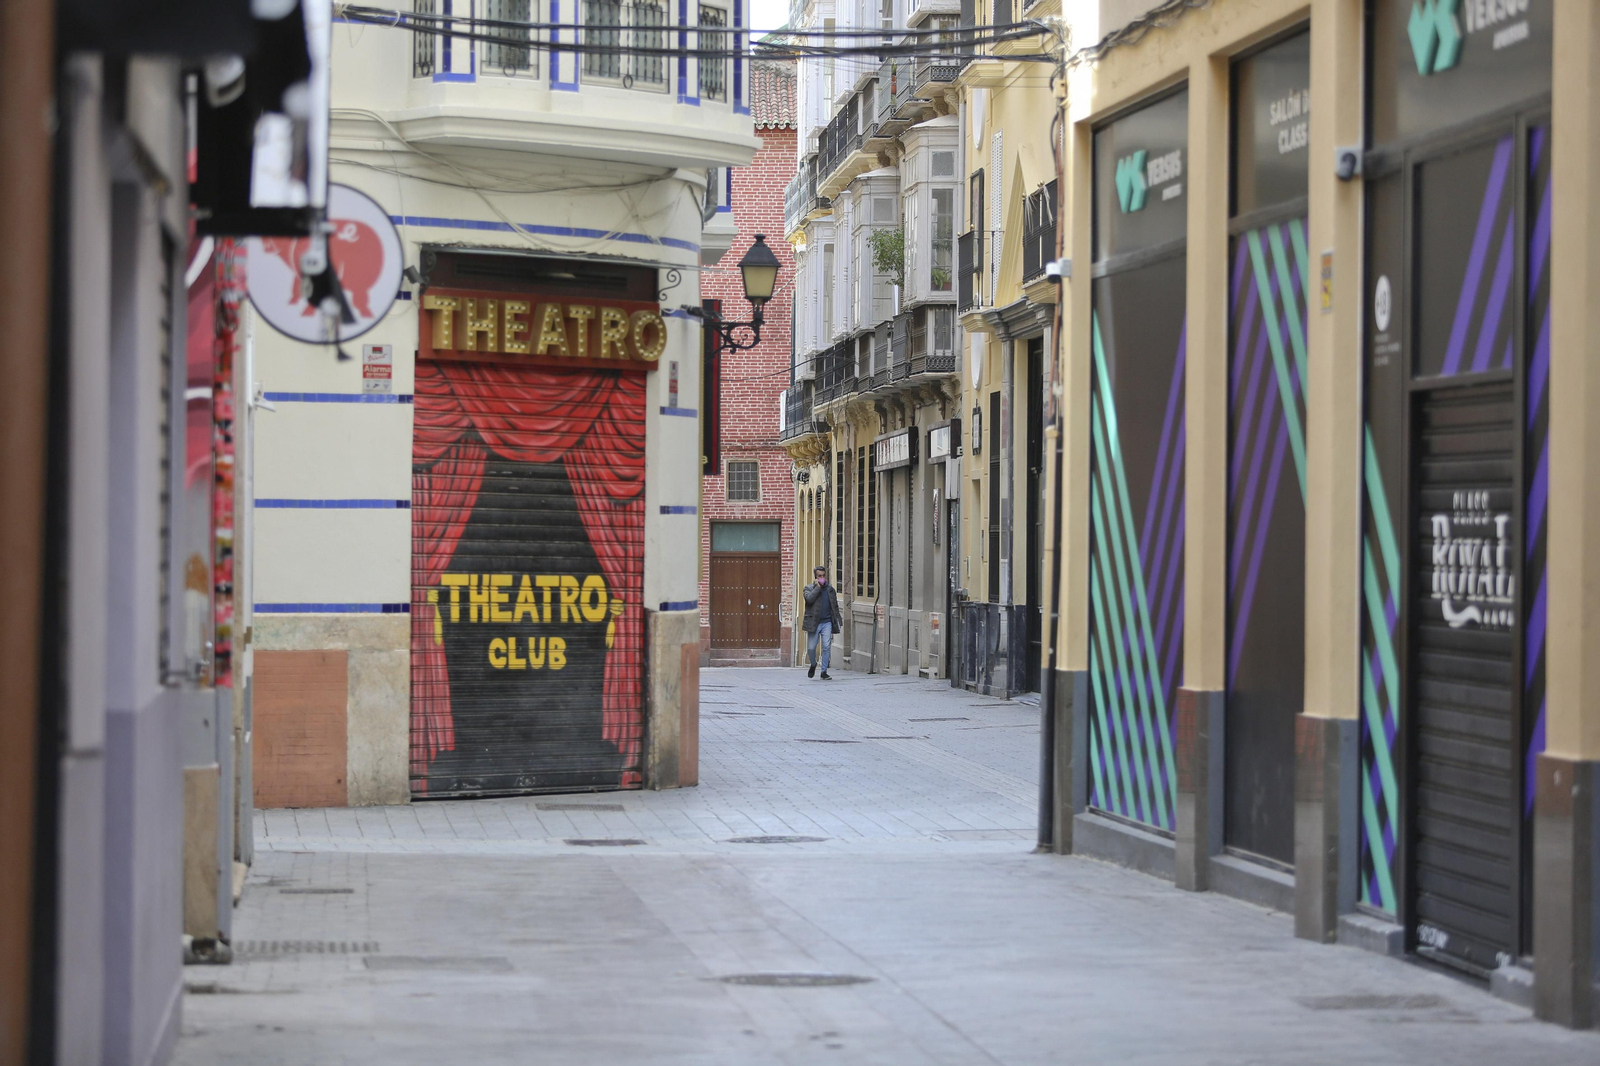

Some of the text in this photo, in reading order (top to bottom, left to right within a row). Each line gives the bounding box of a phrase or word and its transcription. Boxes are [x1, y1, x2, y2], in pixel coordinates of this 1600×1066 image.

[424, 294, 668, 362] THEATRO
[364, 365, 391, 373] Alarma
[441, 574, 607, 623] THEATRO
[488, 637, 567, 670] CLUB
